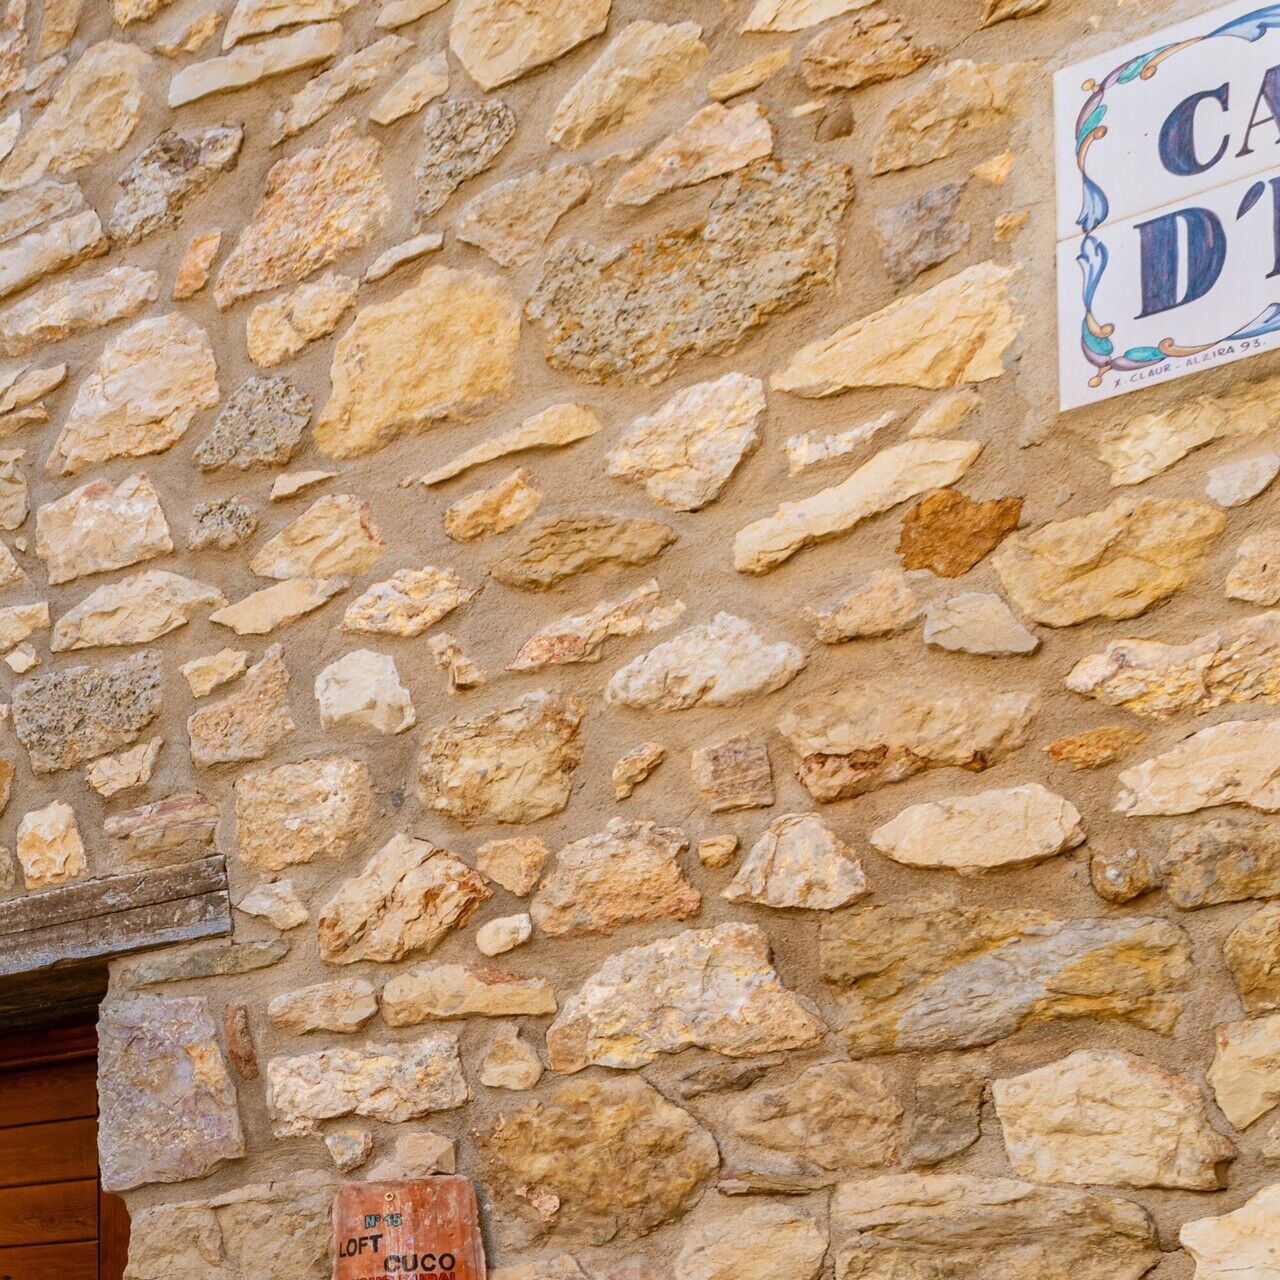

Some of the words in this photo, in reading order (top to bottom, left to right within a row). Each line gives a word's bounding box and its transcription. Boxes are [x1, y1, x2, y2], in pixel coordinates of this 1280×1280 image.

[385, 1213, 402, 1227] 15
[339, 1233, 383, 1258] LOFT
[383, 1252, 456, 1273] CUCO
